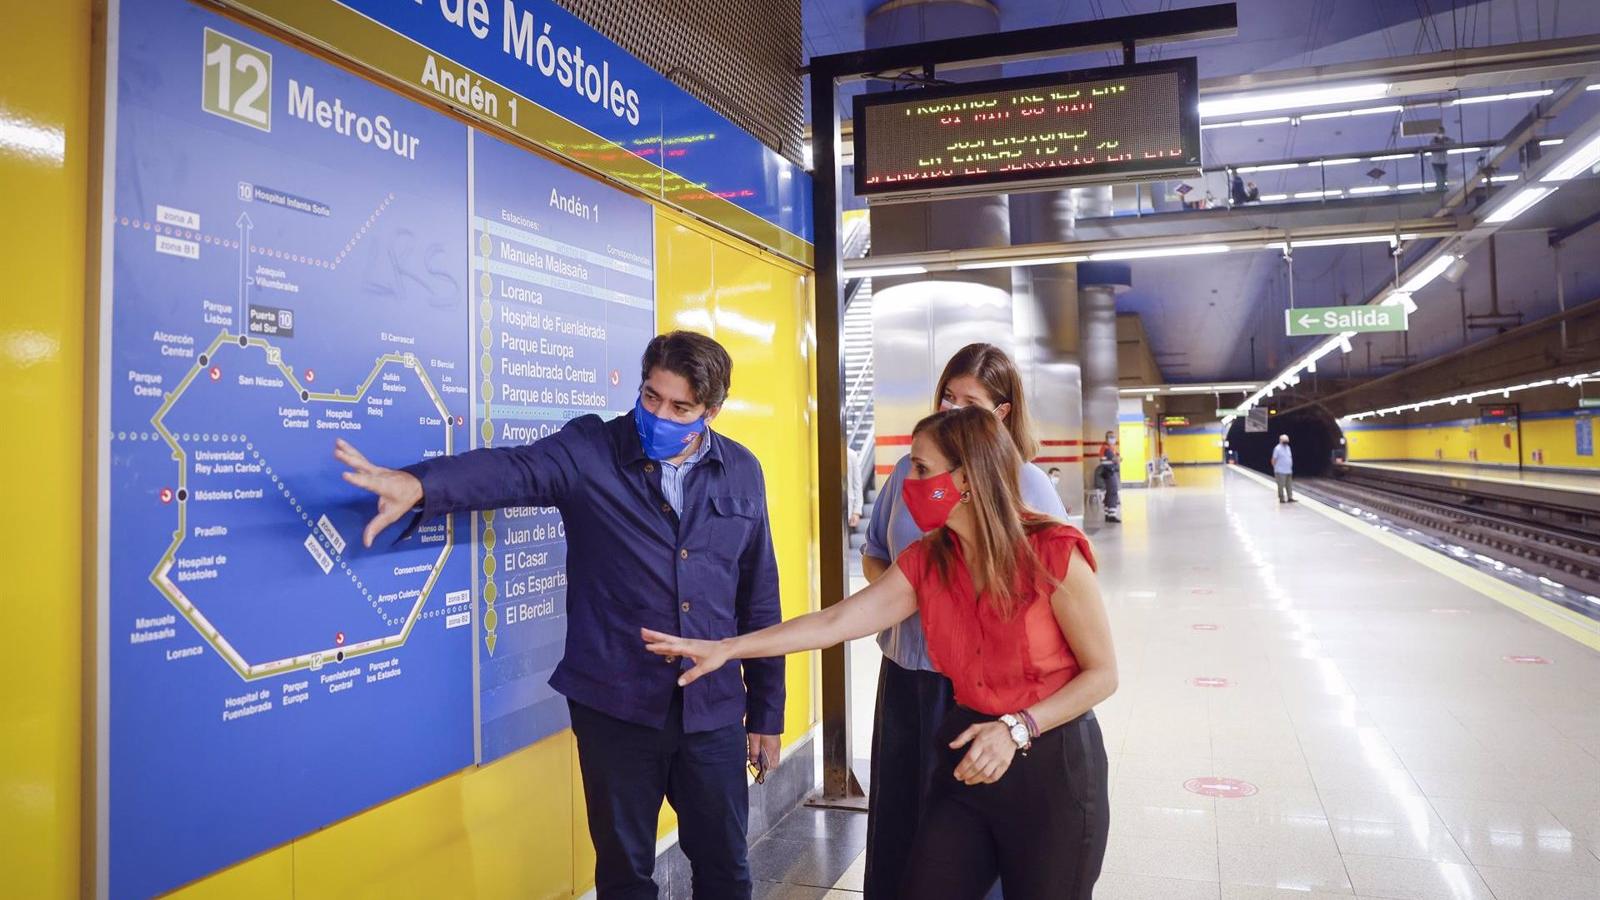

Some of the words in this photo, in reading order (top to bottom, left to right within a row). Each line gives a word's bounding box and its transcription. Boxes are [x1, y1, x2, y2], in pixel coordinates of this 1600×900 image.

[503, 0, 640, 126] Móstoles
[205, 43, 269, 125] 12
[420, 55, 498, 118] Andén
[508, 98, 517, 127] 1
[288, 79, 420, 161] MetroSur
[239, 184, 252, 199] 10
[254, 188, 285, 206] Hospital
[286, 196, 312, 212] Infanta
[549, 187, 590, 220] Andén
[593, 204, 599, 223] 1
[164, 211, 183, 223] zona
[185, 214, 194, 226] A
[501, 208, 540, 231] Estaciones:
[160, 240, 182, 252] zona
[183, 243, 196, 256] B1
[501, 242, 544, 269] Manuela
[545, 254, 589, 281] Malasaña
[501, 280, 543, 306] Loranca
[203, 300, 232, 314] Parque
[204, 314, 232, 327] Lisboa
[250, 309, 276, 322] Puerta
[280, 313, 292, 327] 10
[1323, 310, 1390, 329] Salida
[250, 322, 263, 333] del
[264, 323, 278, 335] Sur
[501, 307, 540, 332] Hospital
[542, 316, 554, 331] de
[555, 317, 606, 341] Fuenlabrada
[153, 331, 194, 345] Alcorcón
[381, 332, 388, 341] El
[389, 333, 415, 345] Carrascal
[501, 332, 539, 355] Parque
[541, 338, 574, 359] Europa
[161, 344, 194, 358] Central
[268, 350, 280, 362] 12
[501, 357, 562, 380] Fuenlabrada
[565, 365, 597, 384] Central
[128, 371, 162, 386] Parque
[239, 375, 255, 387] San
[256, 377, 284, 389] Nicasio
[134, 385, 162, 398] Oeste
[502, 383, 540, 403] Parque
[541, 387, 554, 404] de
[555, 389, 570, 406] los
[571, 391, 606, 408] Estados
[368, 396, 383, 406] Casa
[384, 397, 393, 406] del
[279, 407, 309, 420] Leganés
[326, 409, 353, 421] Hospital
[368, 406, 383, 417] Reloj
[283, 418, 309, 429] Central
[316, 419, 340, 430] Severo
[341, 420, 362, 431] Ochoa
[420, 417, 426, 426] El
[502, 423, 539, 444] Arroyo
[195, 450, 244, 461] Universidad
[423, 449, 436, 458] Juan
[437, 449, 444, 458] de
[195, 463, 212, 475] Rey
[213, 463, 234, 474] Juan
[235, 463, 261, 474] Carlos
[195, 489, 233, 501] Móstoles
[235, 488, 263, 500] Central
[195, 525, 228, 537] Pradillo
[319, 519, 336, 539] zona
[504, 528, 531, 545] Juan
[532, 524, 545, 541] de
[547, 523, 556, 539] la
[307, 538, 324, 559] zona
[178, 555, 213, 569] Hospital
[214, 554, 227, 565] de
[504, 553, 516, 571] El
[518, 550, 548, 569] Casar
[178, 568, 218, 582] Móstoles
[394, 563, 432, 577] Conservatorio
[505, 580, 526, 598] Los
[528, 571, 567, 594] Esparta
[378, 592, 398, 604] Arroyo
[506, 607, 517, 625] El
[520, 599, 555, 622] Bercial
[135, 613, 176, 628] Manuela
[130, 626, 176, 645] Malasaña
[166, 645, 203, 661] Loranca
[311, 655, 322, 668] 12
[369, 659, 391, 673] Parque
[391, 657, 399, 667] de
[320, 667, 361, 684] Fuenlabrada
[366, 672, 376, 683] los
[377, 668, 401, 681] Estados
[283, 680, 309, 695] Parque
[329, 679, 353, 694] Central
[225, 690, 259, 708] Hospital
[259, 688, 270, 700] de
[282, 692, 309, 706] Europa
[222, 701, 273, 721] Fuenlabrada
